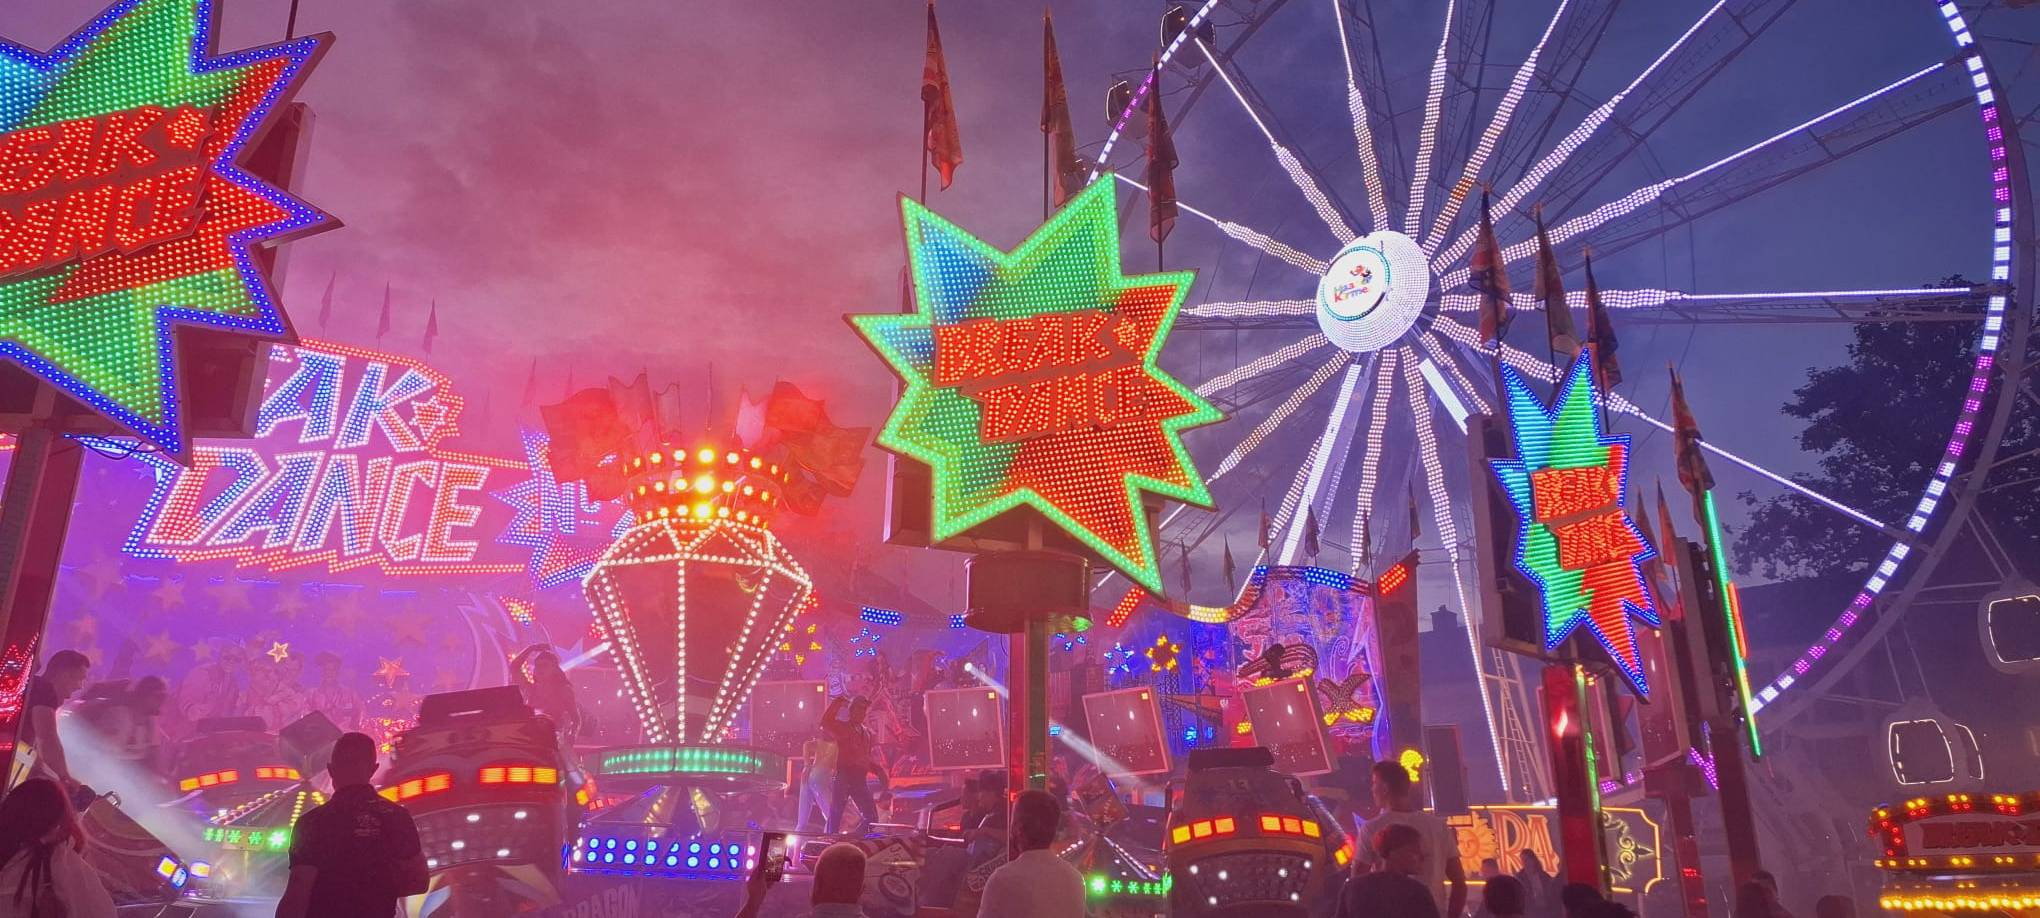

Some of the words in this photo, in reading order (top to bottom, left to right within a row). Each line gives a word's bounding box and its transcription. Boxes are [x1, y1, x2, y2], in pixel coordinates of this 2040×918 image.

[0, 166, 197, 267] ANCE
[938, 314, 1111, 382] BREAK
[257, 346, 438, 451] AK
[978, 365, 1144, 441] DANCE
[147, 446, 488, 561] DANCE
[1534, 467, 1610, 518] BREAK
